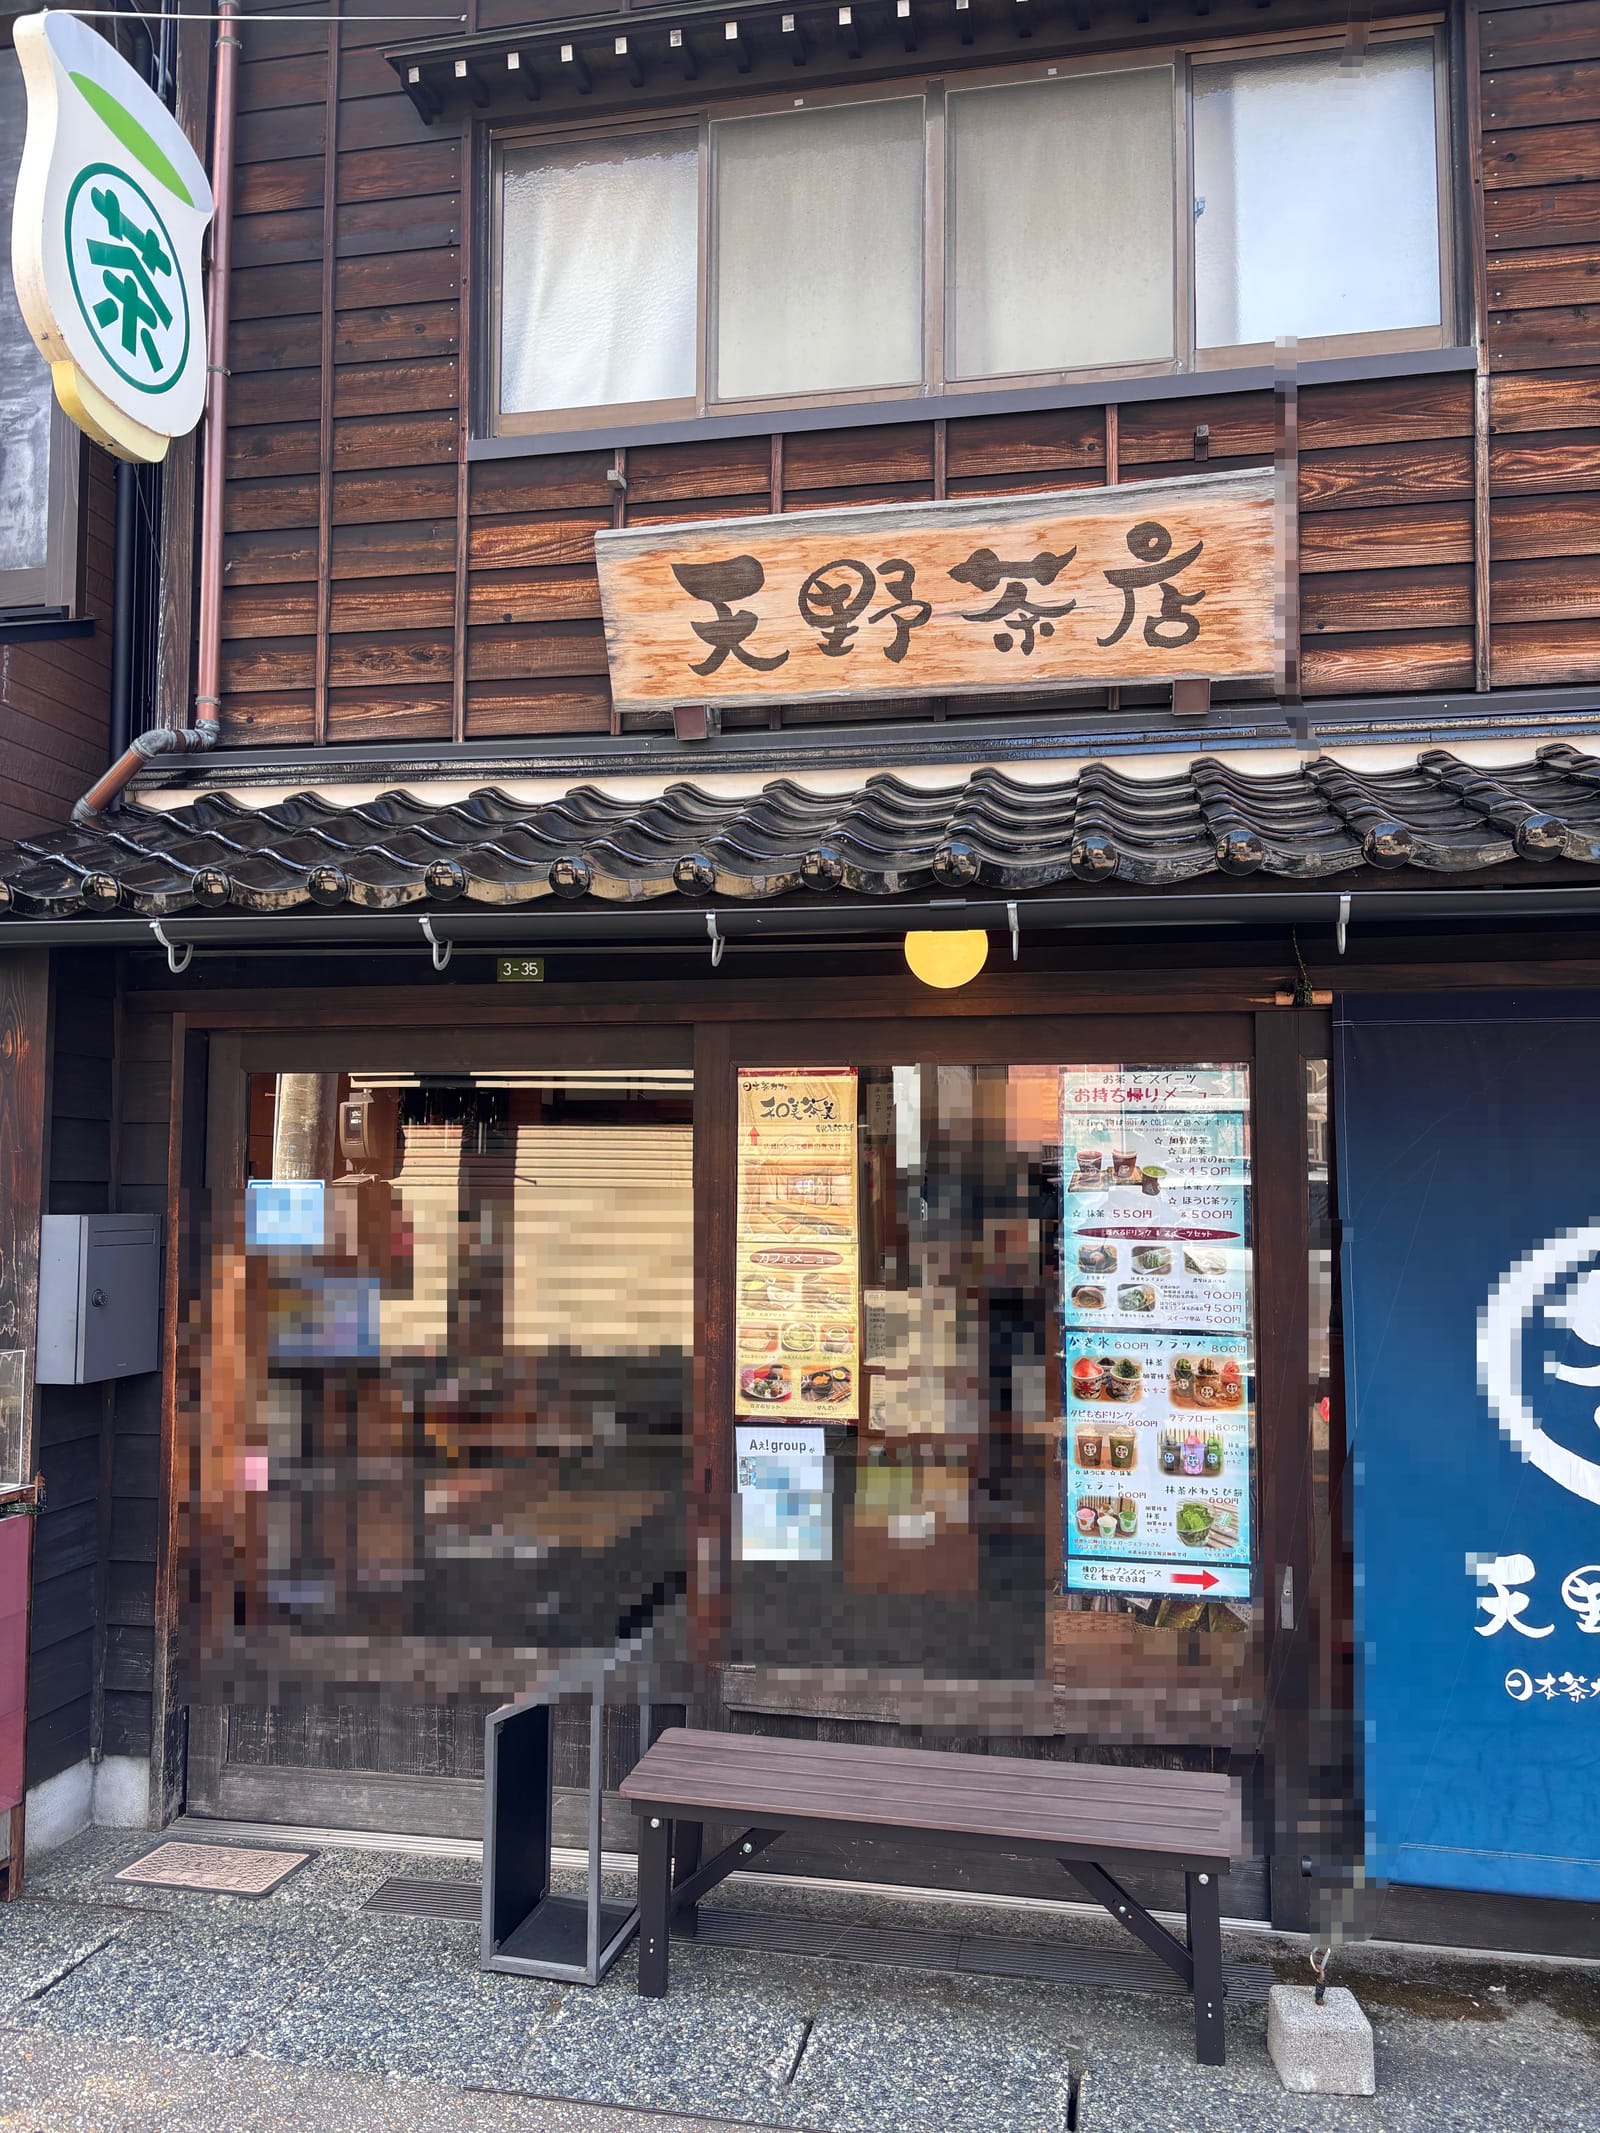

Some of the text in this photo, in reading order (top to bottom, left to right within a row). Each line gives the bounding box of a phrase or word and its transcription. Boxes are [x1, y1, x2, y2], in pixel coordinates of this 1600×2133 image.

[86, 186, 173, 374] 茶
[670, 520, 1207, 677] 天野茶店
[503, 962, 538, 976] 3-35
[1113, 1209, 1153, 1219] 550円
[759, 1254, 838, 1264] カフェメニュー
[1203, 1290, 1242, 1301] 900円
[1203, 1303, 1242, 1314] 950円
[1206, 1316, 1241, 1325] 500円
[1069, 1336, 1149, 1351] かき氷 600円
[1211, 1344, 1246, 1353] 800円
[1070, 1409, 1133, 1420] タピもちドリンク
[1127, 1419, 1158, 1427] 800円
[1169, 1413, 1246, 1432] ラテフロート 800円
[1074, 1481, 1147, 1499] ジェラート 600円
[1208, 1497, 1239, 1505] 600円
